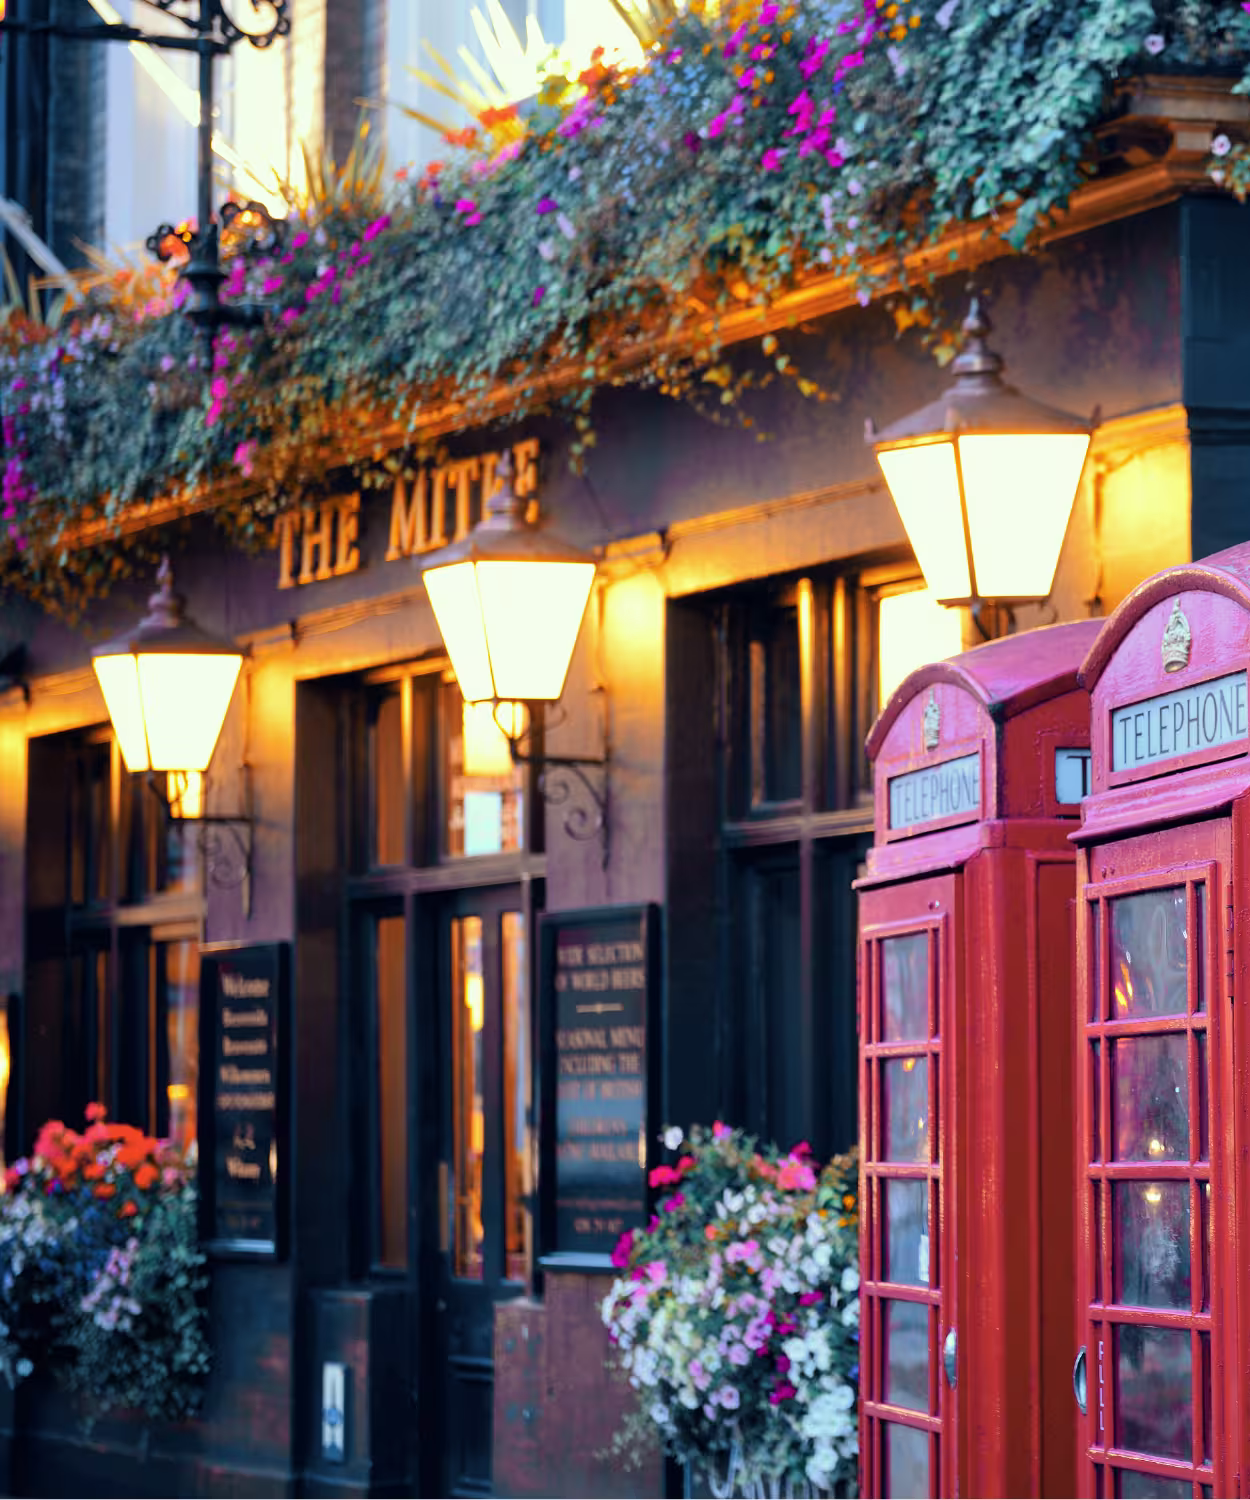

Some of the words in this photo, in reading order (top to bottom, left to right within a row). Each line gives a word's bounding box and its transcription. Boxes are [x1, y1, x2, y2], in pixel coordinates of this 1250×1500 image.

[275, 489, 361, 590] THE
[1119, 682, 1247, 765] TELEPHONE
[895, 762, 980, 822] TELEPHONE
